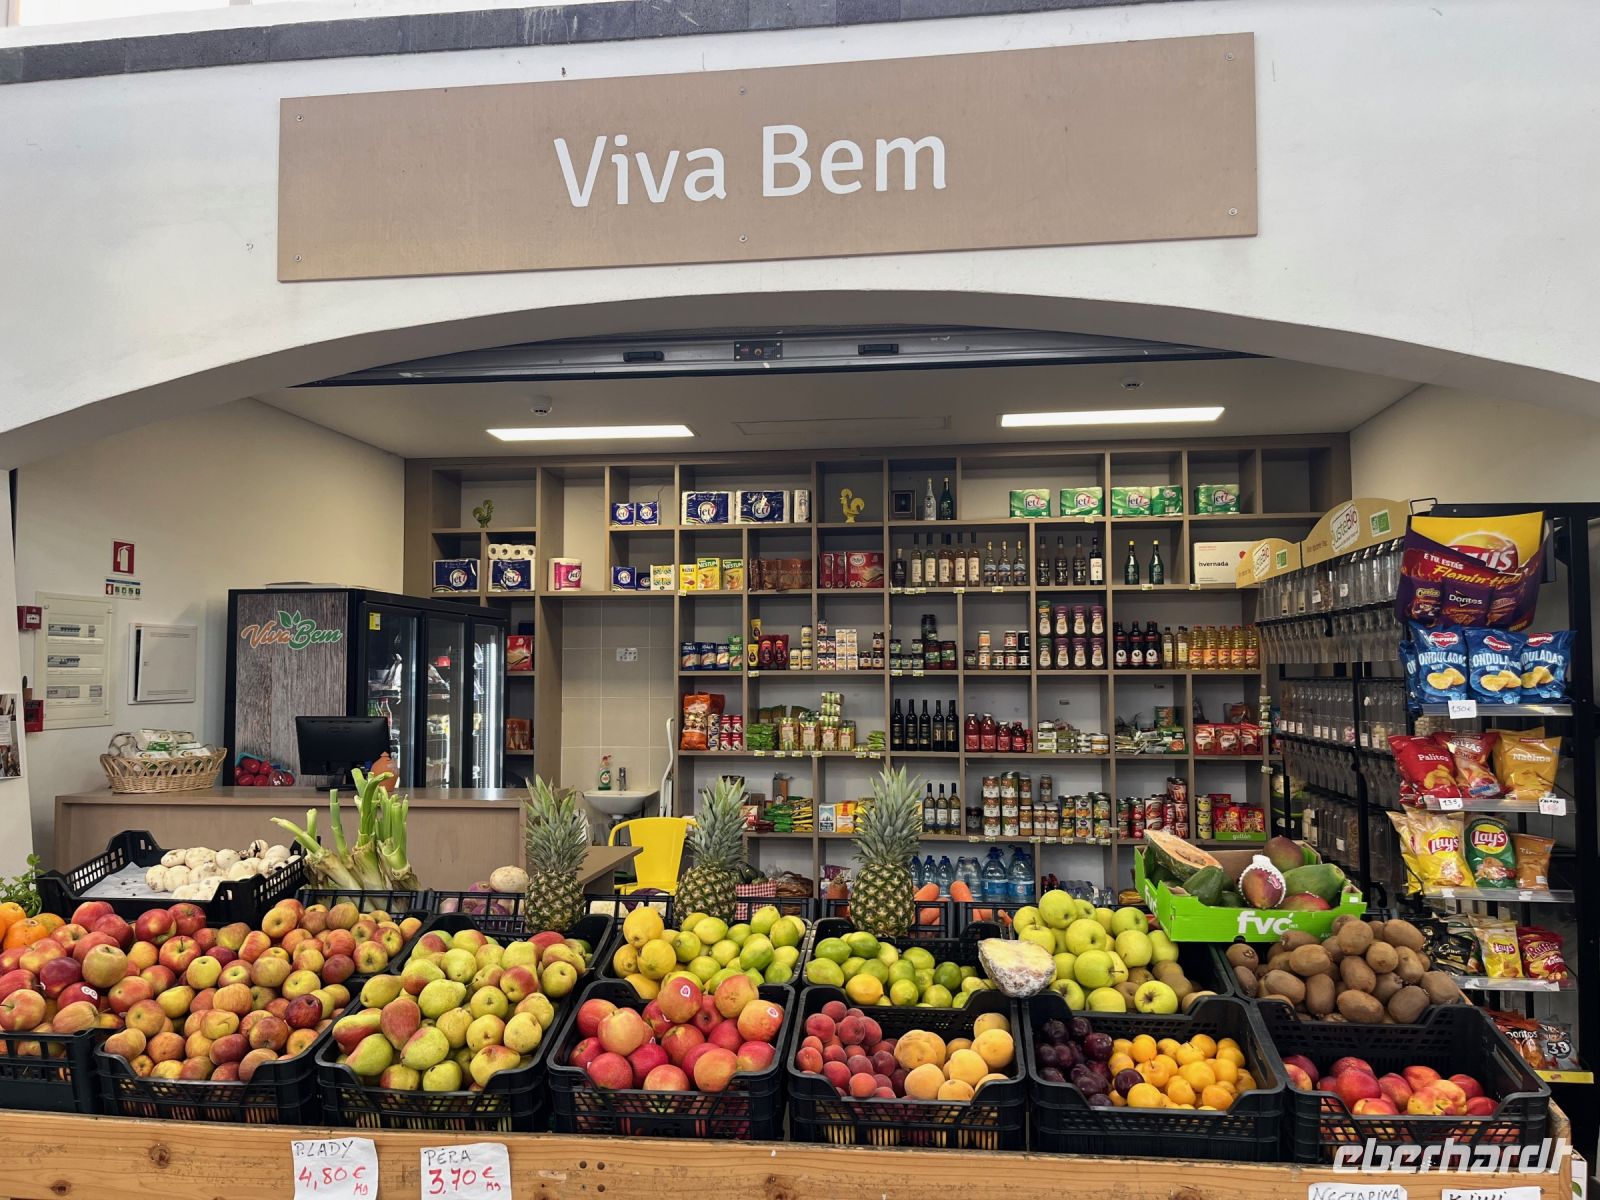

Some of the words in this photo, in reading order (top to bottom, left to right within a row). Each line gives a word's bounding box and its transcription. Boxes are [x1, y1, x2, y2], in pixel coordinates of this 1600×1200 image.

[553, 134, 727, 208] Viva
[762, 124, 947, 197] Bem
[1025, 495, 1041, 508] jet7
[1075, 495, 1092, 508] jet7
[1128, 495, 1144, 508] jet7
[1441, 557, 1464, 570] ESTÁS
[1448, 594, 1483, 606] Doritos
[241, 620, 292, 649] Viva
[288, 618, 343, 650] Bem
[1418, 753, 1449, 762] Palitos
[1431, 836, 1460, 853] Lay's
[1474, 829, 1506, 847] Lay's
[1237, 911, 1293, 935] fvc
[294, 1141, 354, 1160] P.LADY
